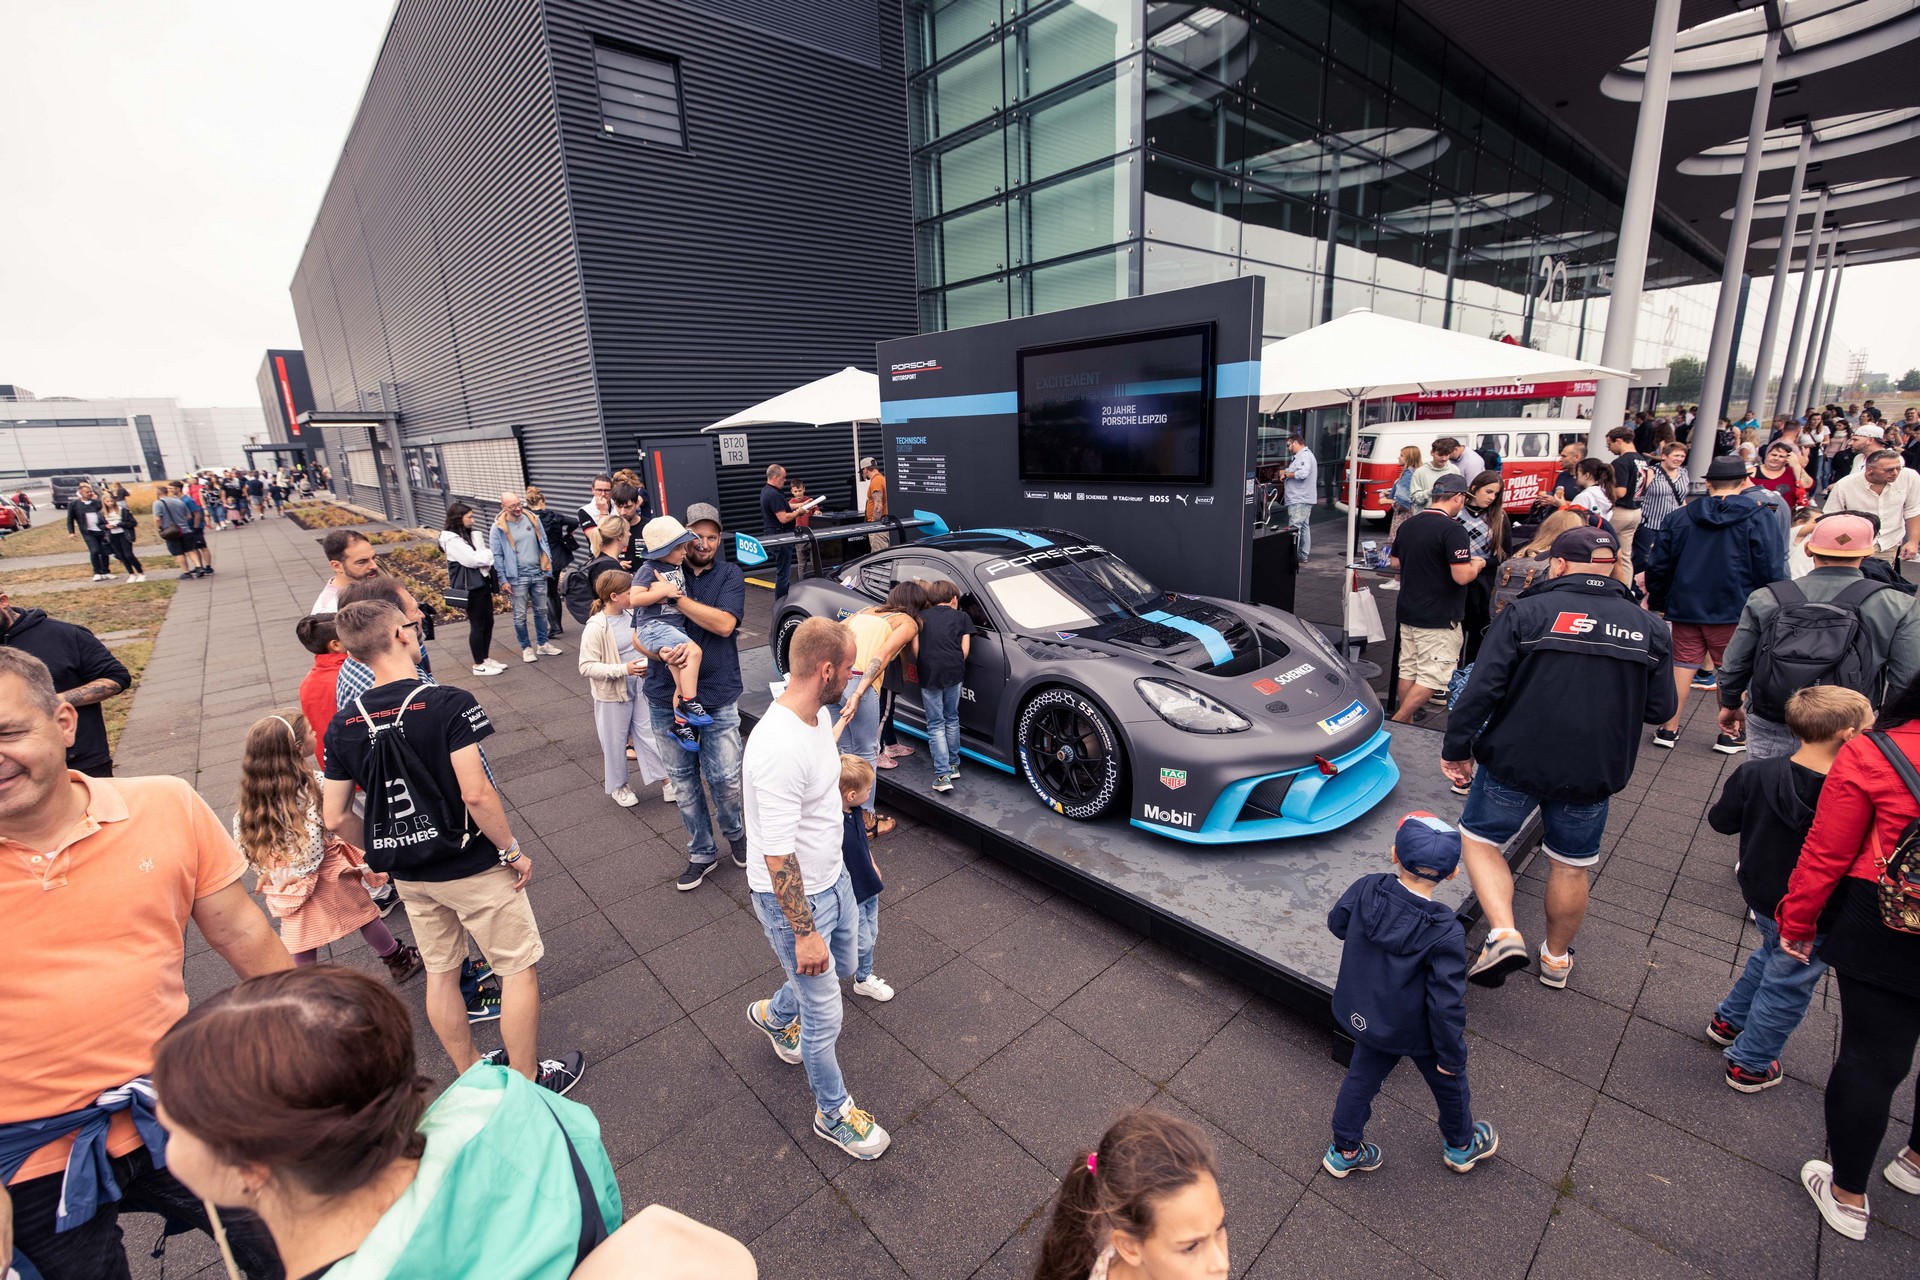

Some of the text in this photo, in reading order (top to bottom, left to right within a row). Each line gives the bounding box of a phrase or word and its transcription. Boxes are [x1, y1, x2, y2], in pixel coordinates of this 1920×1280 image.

[891, 359, 937, 371] PORSCHE
[892, 373, 917, 381] MOTORSPORT
[1036, 371, 1101, 390] EXCITEMENT
[1484, 384, 1535, 396] BULLEN
[1101, 405, 1137, 416] 20 JAHRE
[1101, 414, 1168, 426] PORSCHE LEIPZIG
[723, 437, 745, 449] BT20
[895, 436, 927, 445] TECHNISCHE
[728, 450, 743, 461] TR3
[1507, 473, 1544, 490] POKAL-
[1053, 491, 1073, 500] Mobil
[1149, 495, 1170, 503] BOSS
[1512, 485, 1539, 501] 2022
[738, 538, 758, 554] BOSS
[985, 544, 1107, 576] PORSCHE
[1605, 623, 1644, 641] line
[1274, 663, 1316, 685] SCHENKER
[1337, 705, 1363, 725] MICHELIN
[1019, 750, 1049, 801] MICHELIN
[1162, 769, 1185, 779] TAG
[1160, 776, 1186, 788] HEUER
[1144, 803, 1193, 827] Mobil
